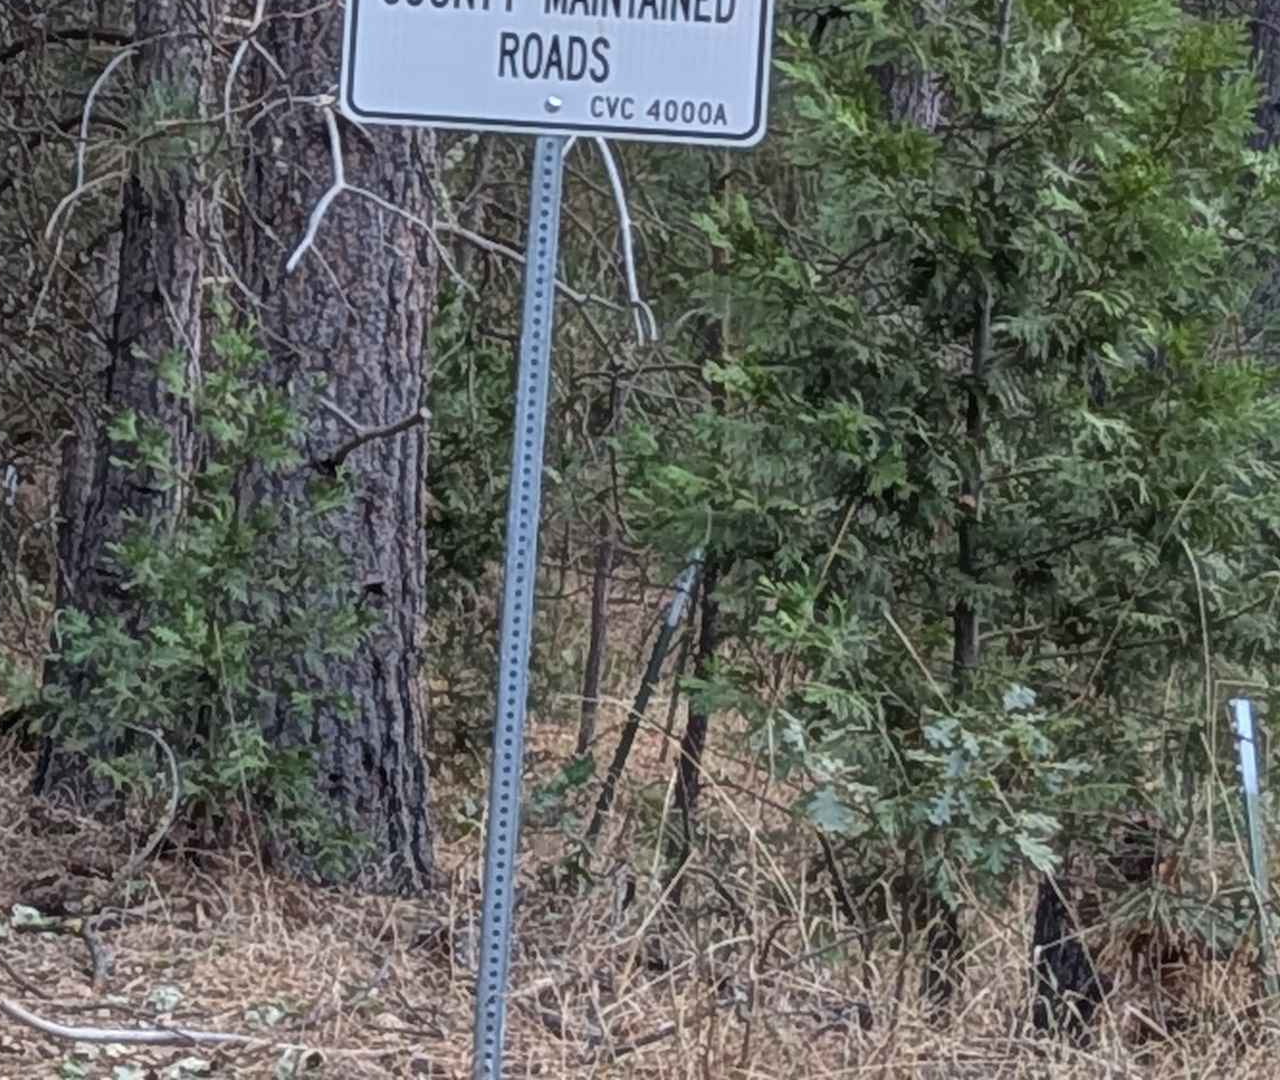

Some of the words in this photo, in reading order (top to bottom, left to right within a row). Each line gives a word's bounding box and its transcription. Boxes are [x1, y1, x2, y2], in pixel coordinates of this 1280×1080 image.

[498, 32, 611, 83] ROADS
[590, 95, 635, 120] CVC
[646, 99, 728, 126] 4000A
